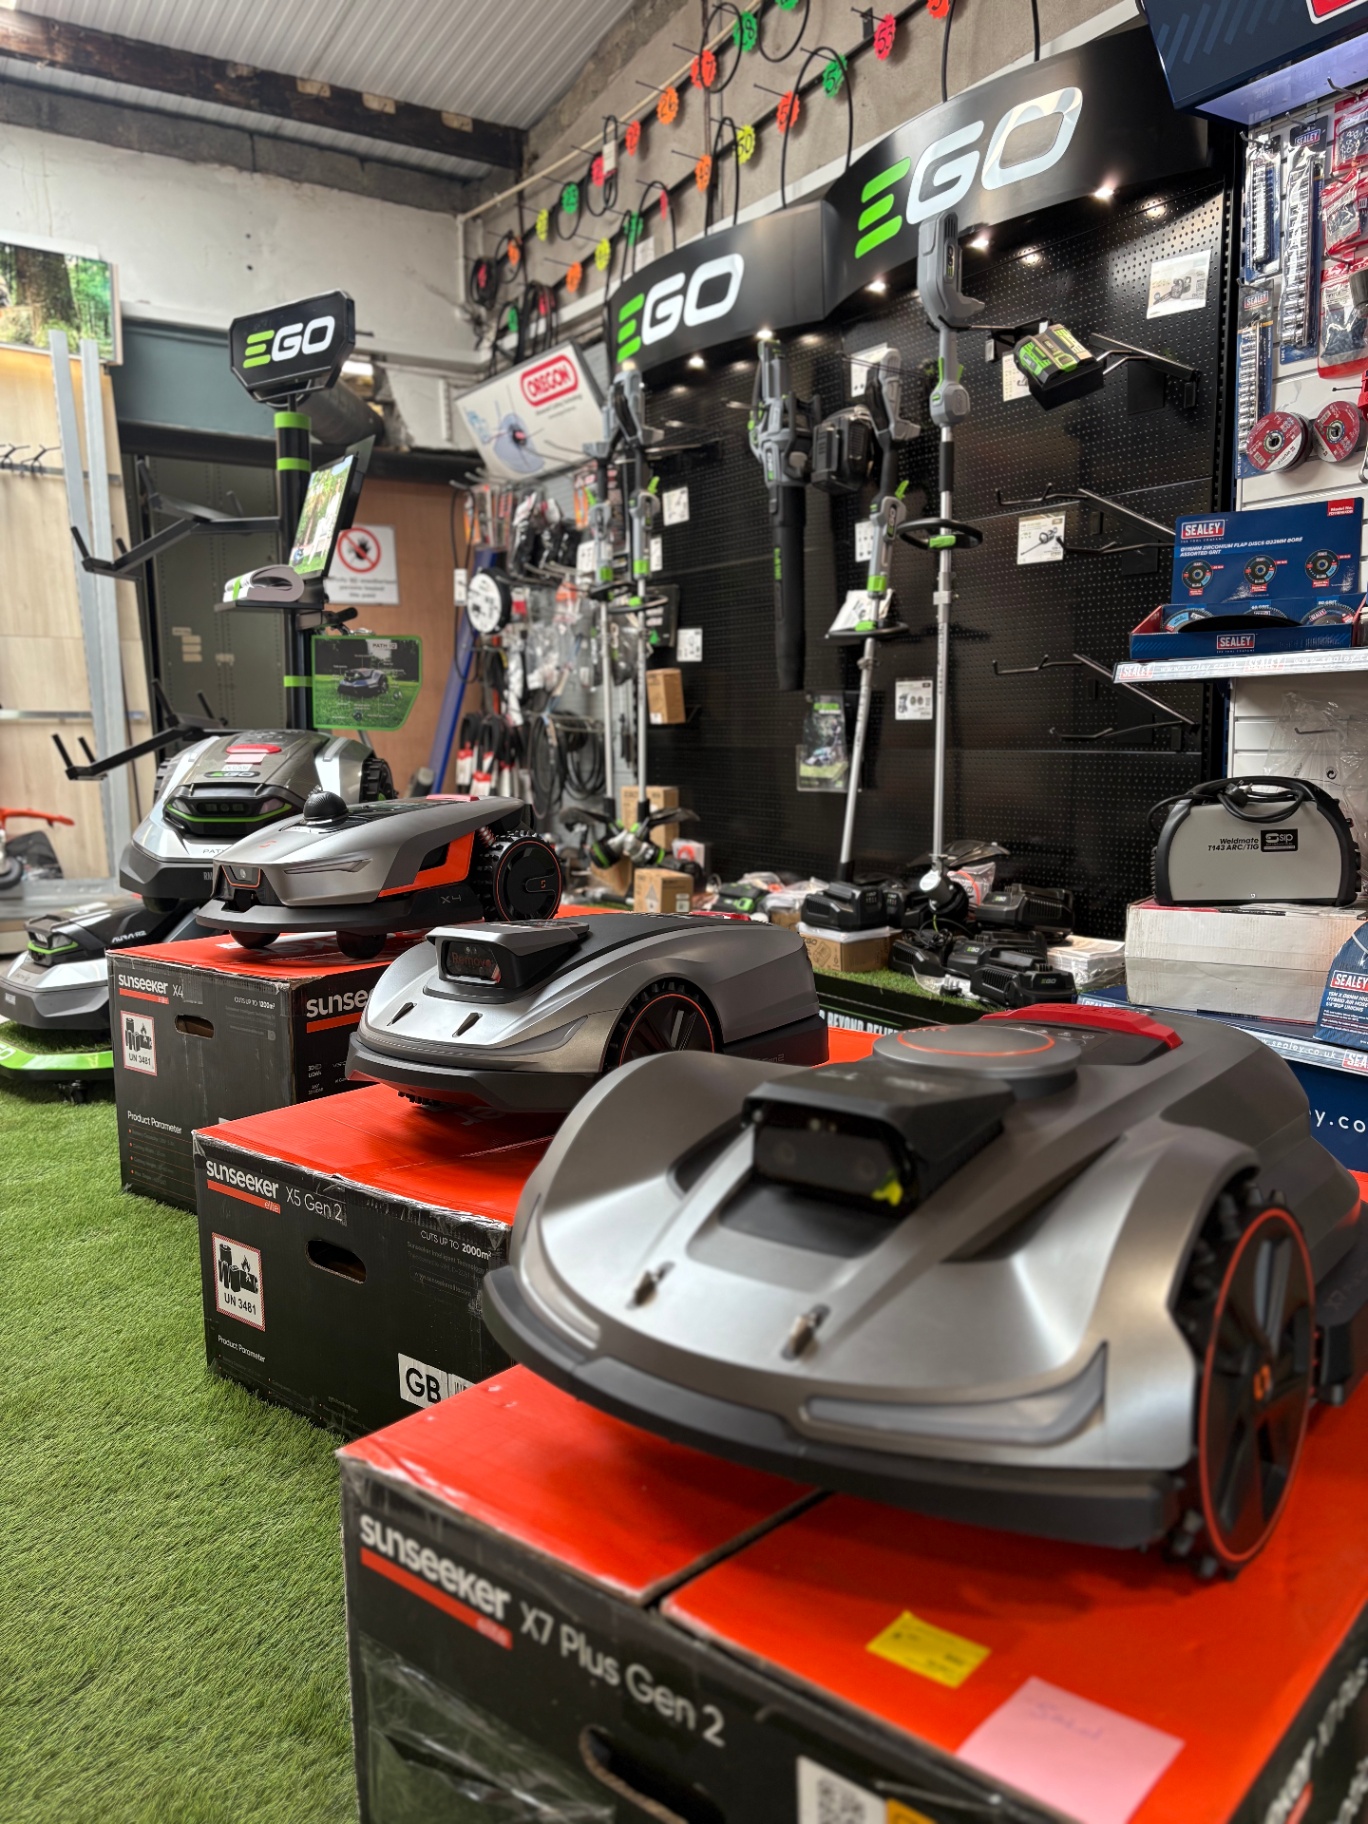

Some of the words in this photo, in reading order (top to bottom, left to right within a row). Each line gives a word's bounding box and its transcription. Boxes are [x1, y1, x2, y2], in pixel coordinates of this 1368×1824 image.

[854, 86, 1084, 259] EGO
[617, 253, 745, 363] EGO
[242, 315, 335, 369] EGO
[527, 364, 573, 397] OREGON
[1184, 521, 1222, 537] SEALEY
[1202, 543, 1233, 551] ZIRCONIUM
[1233, 541, 1248, 549] FLAP
[1286, 536, 1304, 544] BORE
[1218, 635, 1252, 648] SEALEY
[1121, 664, 1153, 679] SEALEY
[1247, 656, 1283, 672] SEALEY
[1219, 837, 1259, 845] Weldmate
[1226, 843, 1260, 851] ARC/TIG
[440, 894, 462, 905] X4
[118, 973, 169, 995] sunseeker
[172, 984, 185, 999] X4
[826, 1013, 866, 1034] BEYOND
[129, 1052, 138, 1063] UN
[138, 1054, 151, 1066] 3481
[127, 1110, 151, 1126] Product
[151, 1117, 182, 1134] Parameter
[206, 1160, 279, 1199] sunseeker
[285, 1186, 301, 1207] X5
[304, 1193, 332, 1220] Gen
[334, 1203, 343, 1222] 2
[420, 1229, 439, 1244] CUTS
[439, 1236, 448, 1246] UP
[449, 1239, 460, 1250] TO
[223, 1291, 237, 1307] UN
[237, 1298, 257, 1316] 3481
[217, 1334, 238, 1350] Product
[238, 1342, 266, 1363] Parameter
[405, 1367, 442, 1404] GB
[359, 1514, 513, 1622] sunseeker
[519, 1600, 555, 1645] X7
[559, 1625, 622, 1687] Plus
[624, 1662, 697, 1730] Gen
[702, 1704, 726, 1748] 2
